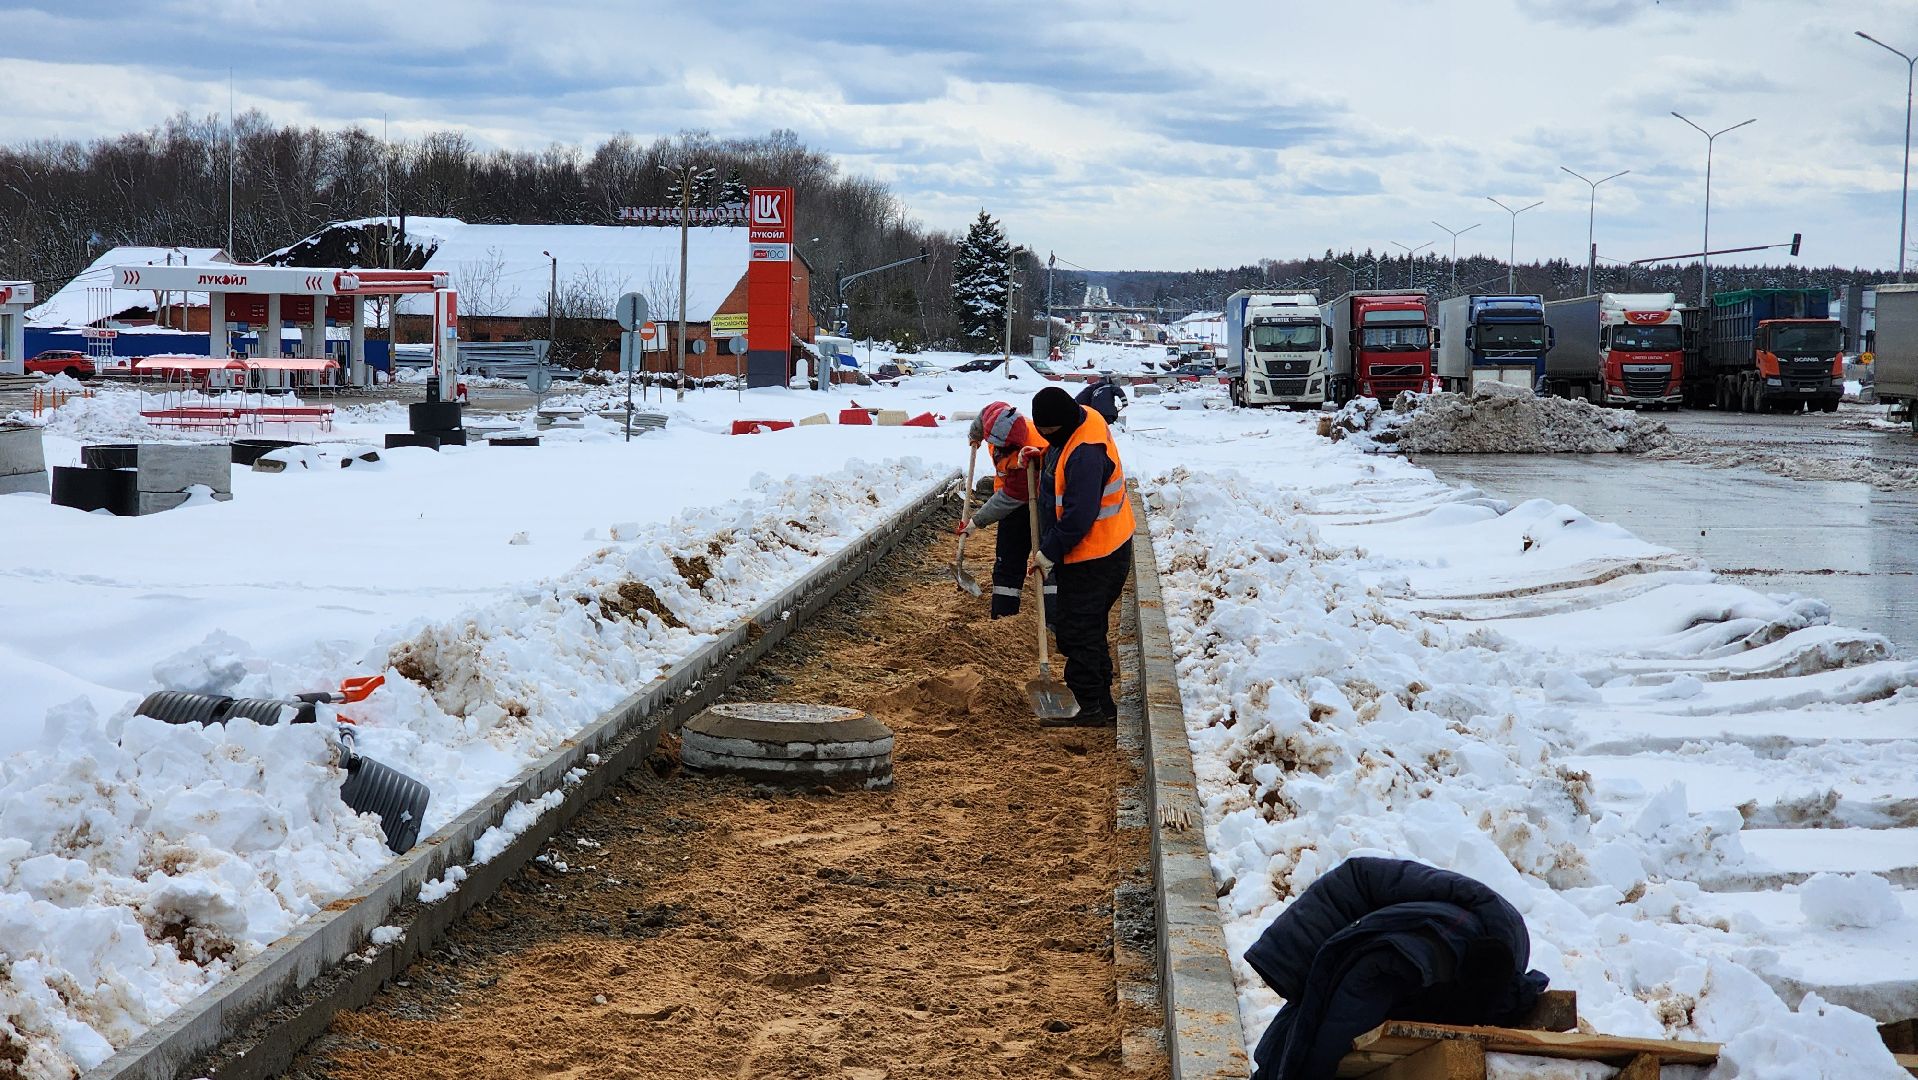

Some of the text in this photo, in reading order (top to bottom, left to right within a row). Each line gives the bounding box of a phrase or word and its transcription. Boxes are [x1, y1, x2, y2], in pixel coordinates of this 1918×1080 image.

[751, 230, 785, 239] ЛУКОЙЛ
[197, 274, 247, 286] ЛУКОЙЛ
[1636, 313, 1660, 321] XF
[237, 375, 244, 385] 6
